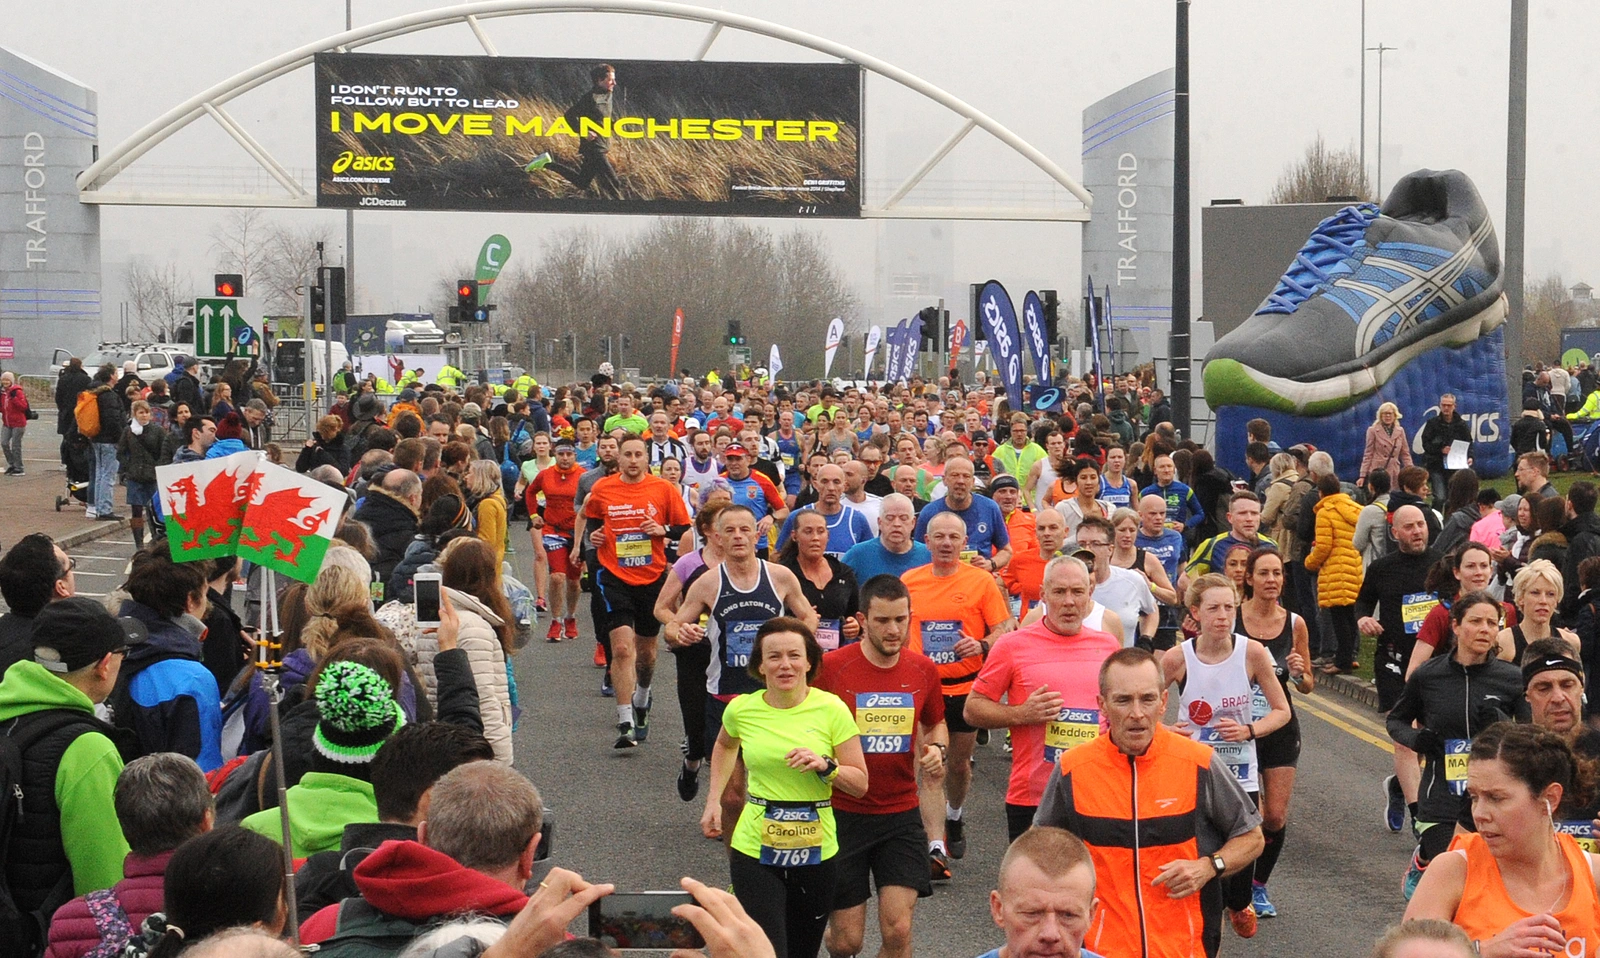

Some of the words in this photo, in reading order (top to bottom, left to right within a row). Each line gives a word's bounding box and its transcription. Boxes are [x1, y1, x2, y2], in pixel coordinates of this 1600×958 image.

[331, 85, 335, 93] I
[339, 85, 391, 96] DON'T
[395, 86, 431, 96] RUN
[434, 87, 457, 96] TO
[331, 96, 405, 106] FOLLOW
[408, 97, 440, 107] BUT
[442, 98, 469, 108] TO
[473, 99, 519, 109] LEAD
[331, 112, 340, 132] I
[353, 112, 492, 135] MOVE
[506, 115, 838, 142] MANCHESTER
[24, 132, 46, 268] TRAFFORD
[359, 197, 407, 206] JCDecaux
[1117, 152, 1137, 286] TRAFFORD
[486, 243, 501, 267] C
[829, 325, 839, 339] A
[955, 326, 962, 344] B
[1460, 412, 1500, 443] ics
[624, 556, 646, 567] 4708
[719, 603, 738, 617] LONG
[739, 600, 764, 608] EATON
[816, 632, 834, 640] hael
[930, 635, 953, 643] Colin
[878, 696, 903, 706] asics
[865, 713, 906, 725] George
[1068, 712, 1092, 721] asics
[1050, 725, 1096, 739] Medders
[867, 736, 903, 753] 2659
[1214, 746, 1243, 756] ammy
[783, 811, 810, 821] asics
[767, 824, 817, 836] Caroline
[1560, 825, 1591, 835] asics
[773, 848, 810, 866] 7769
